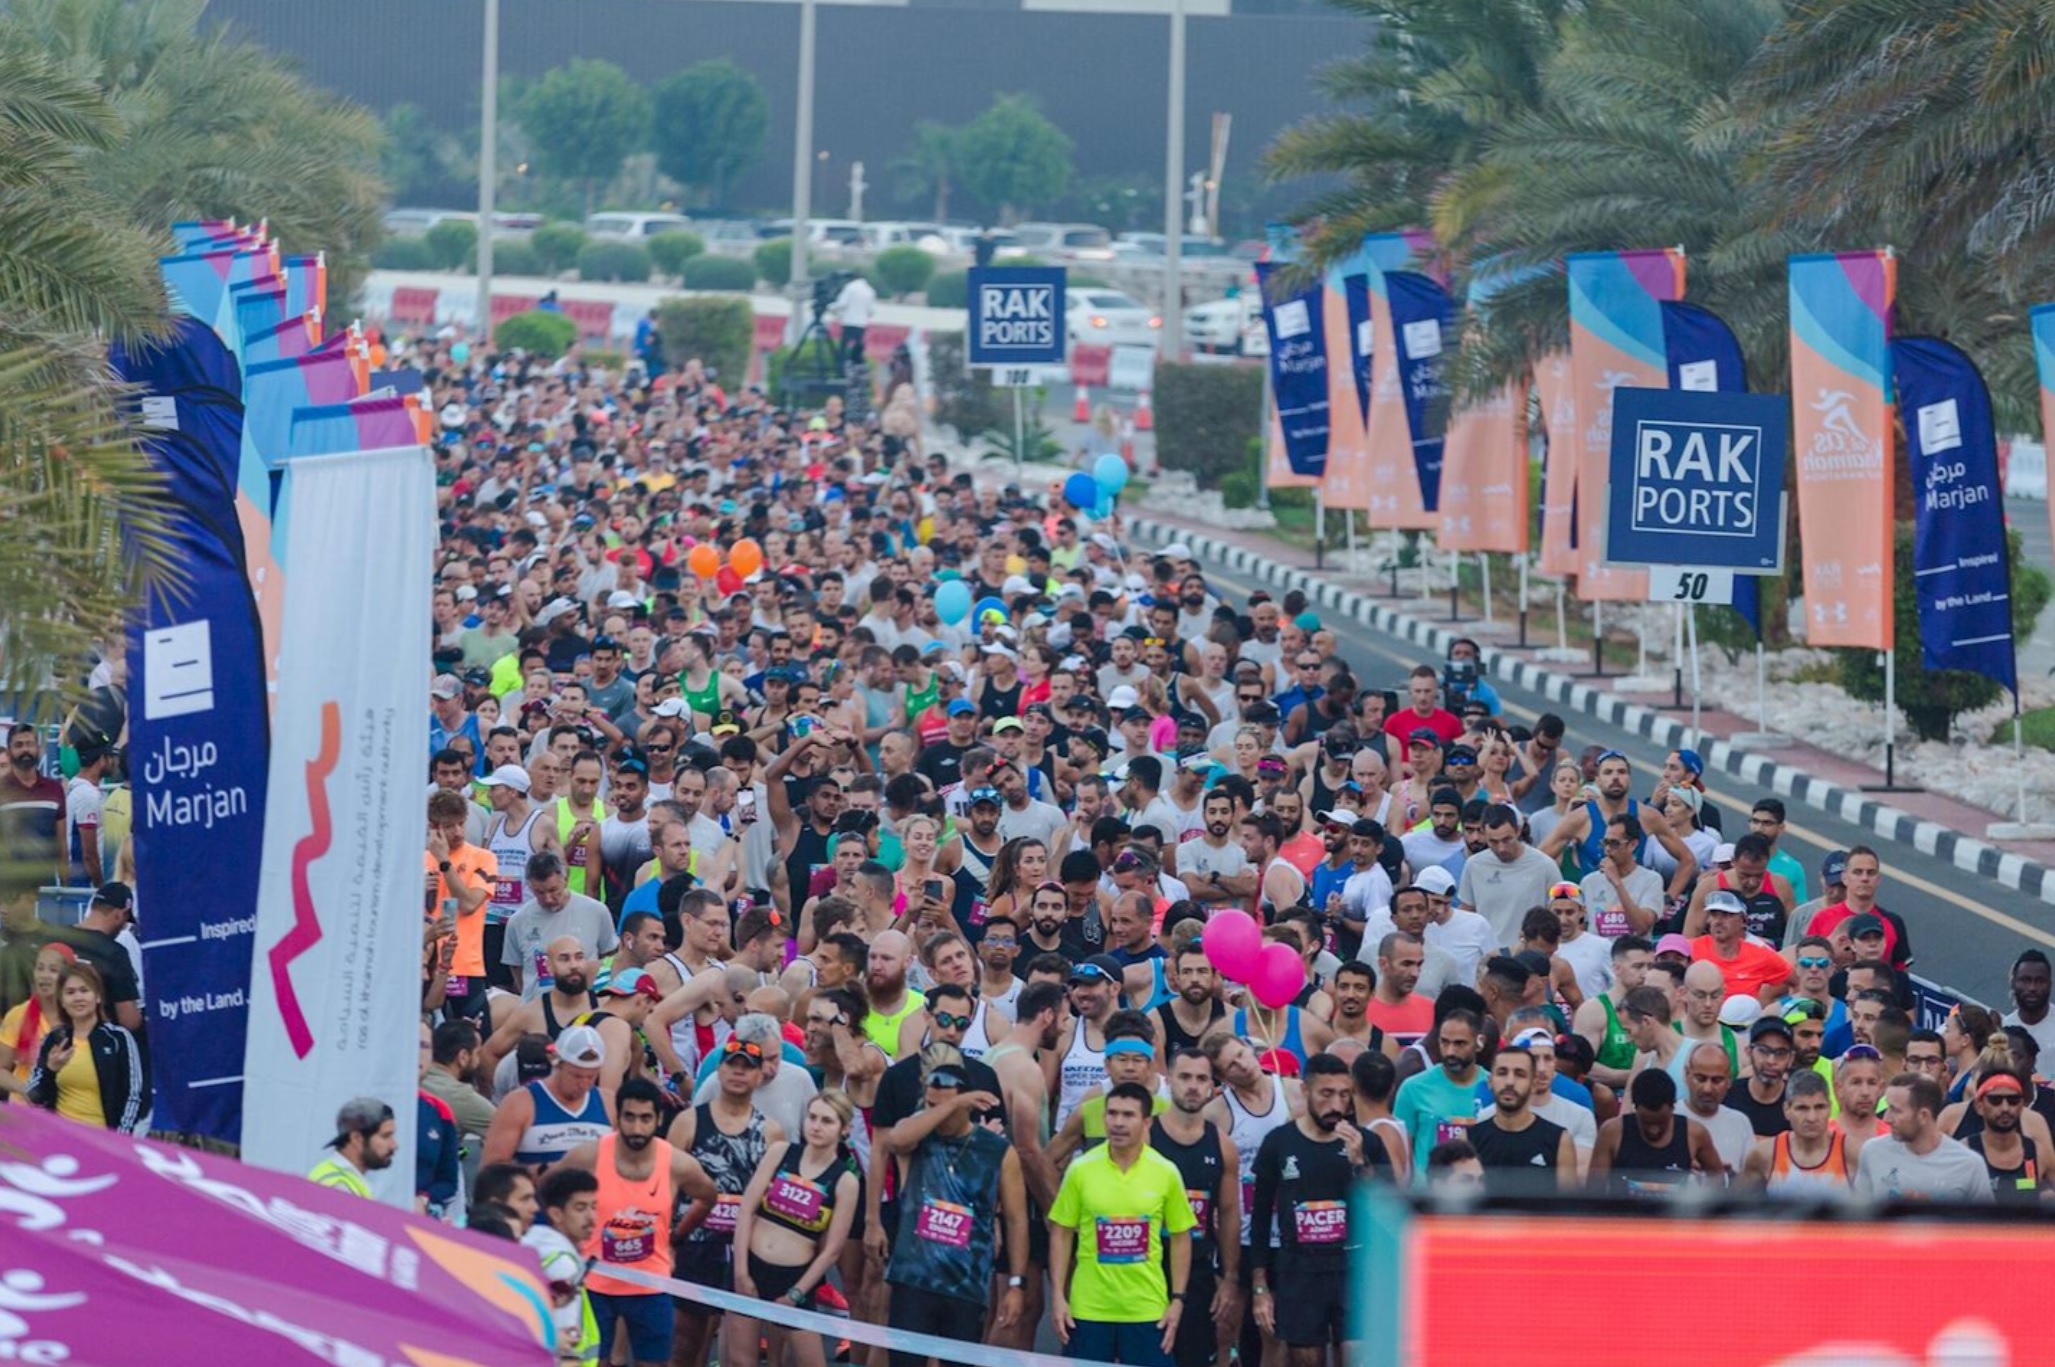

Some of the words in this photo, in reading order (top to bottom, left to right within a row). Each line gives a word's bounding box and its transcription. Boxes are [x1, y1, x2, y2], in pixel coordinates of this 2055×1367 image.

[984, 289, 1050, 319] RAK
[984, 320, 1052, 344] PORTS
[1639, 429, 1755, 485] RAK
[1636, 485, 1754, 529] PORTS
[1926, 484, 1989, 511] Marjan
[1674, 571, 1708, 601] 50
[144, 736, 218, 785] مرجان
[146, 783, 247, 829] Marjan
[201, 914, 256, 941] Inspired
[1604, 912, 1625, 924] 680
[159, 1000, 178, 1019] by
[180, 994, 205, 1013] the
[206, 988, 244, 1011] Land
[779, 1183, 812, 1206] 3122
[929, 1209, 964, 1228] 2147
[1296, 1209, 1346, 1226] PACER
[615, 1239, 642, 1251] 665
[1105, 1225, 1142, 1239] 2209
